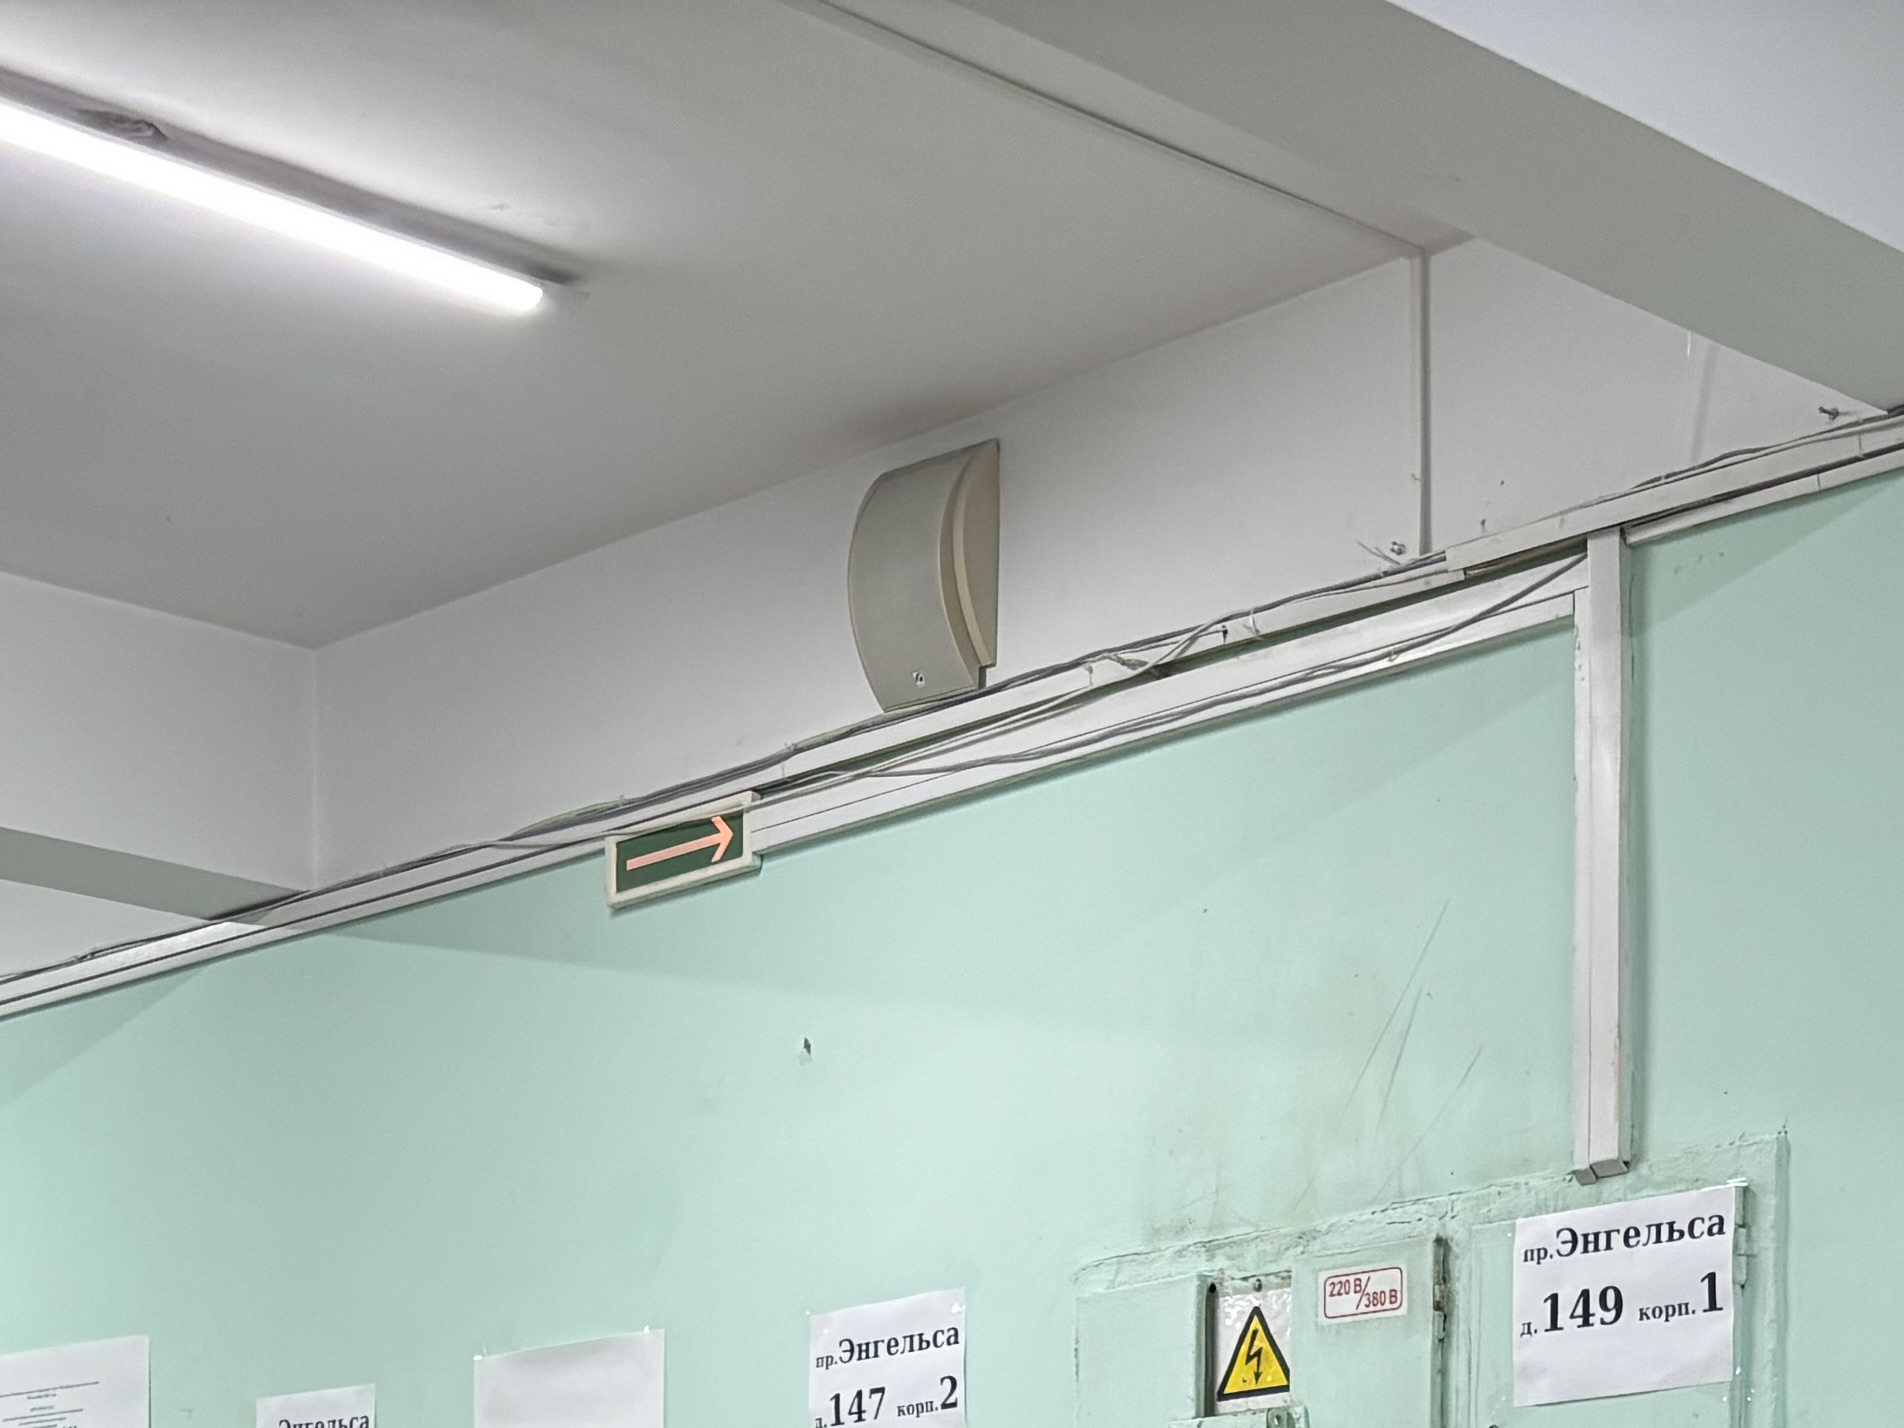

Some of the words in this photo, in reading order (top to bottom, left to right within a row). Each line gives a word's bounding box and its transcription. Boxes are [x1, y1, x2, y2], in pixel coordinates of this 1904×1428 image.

[1523, 1213, 1726, 1265] пр.Энгельса
[1328, 1279, 1351, 1297] 220
[1364, 1290, 1386, 1308] 380
[815, 1326, 960, 1370] пр.Энгельса
